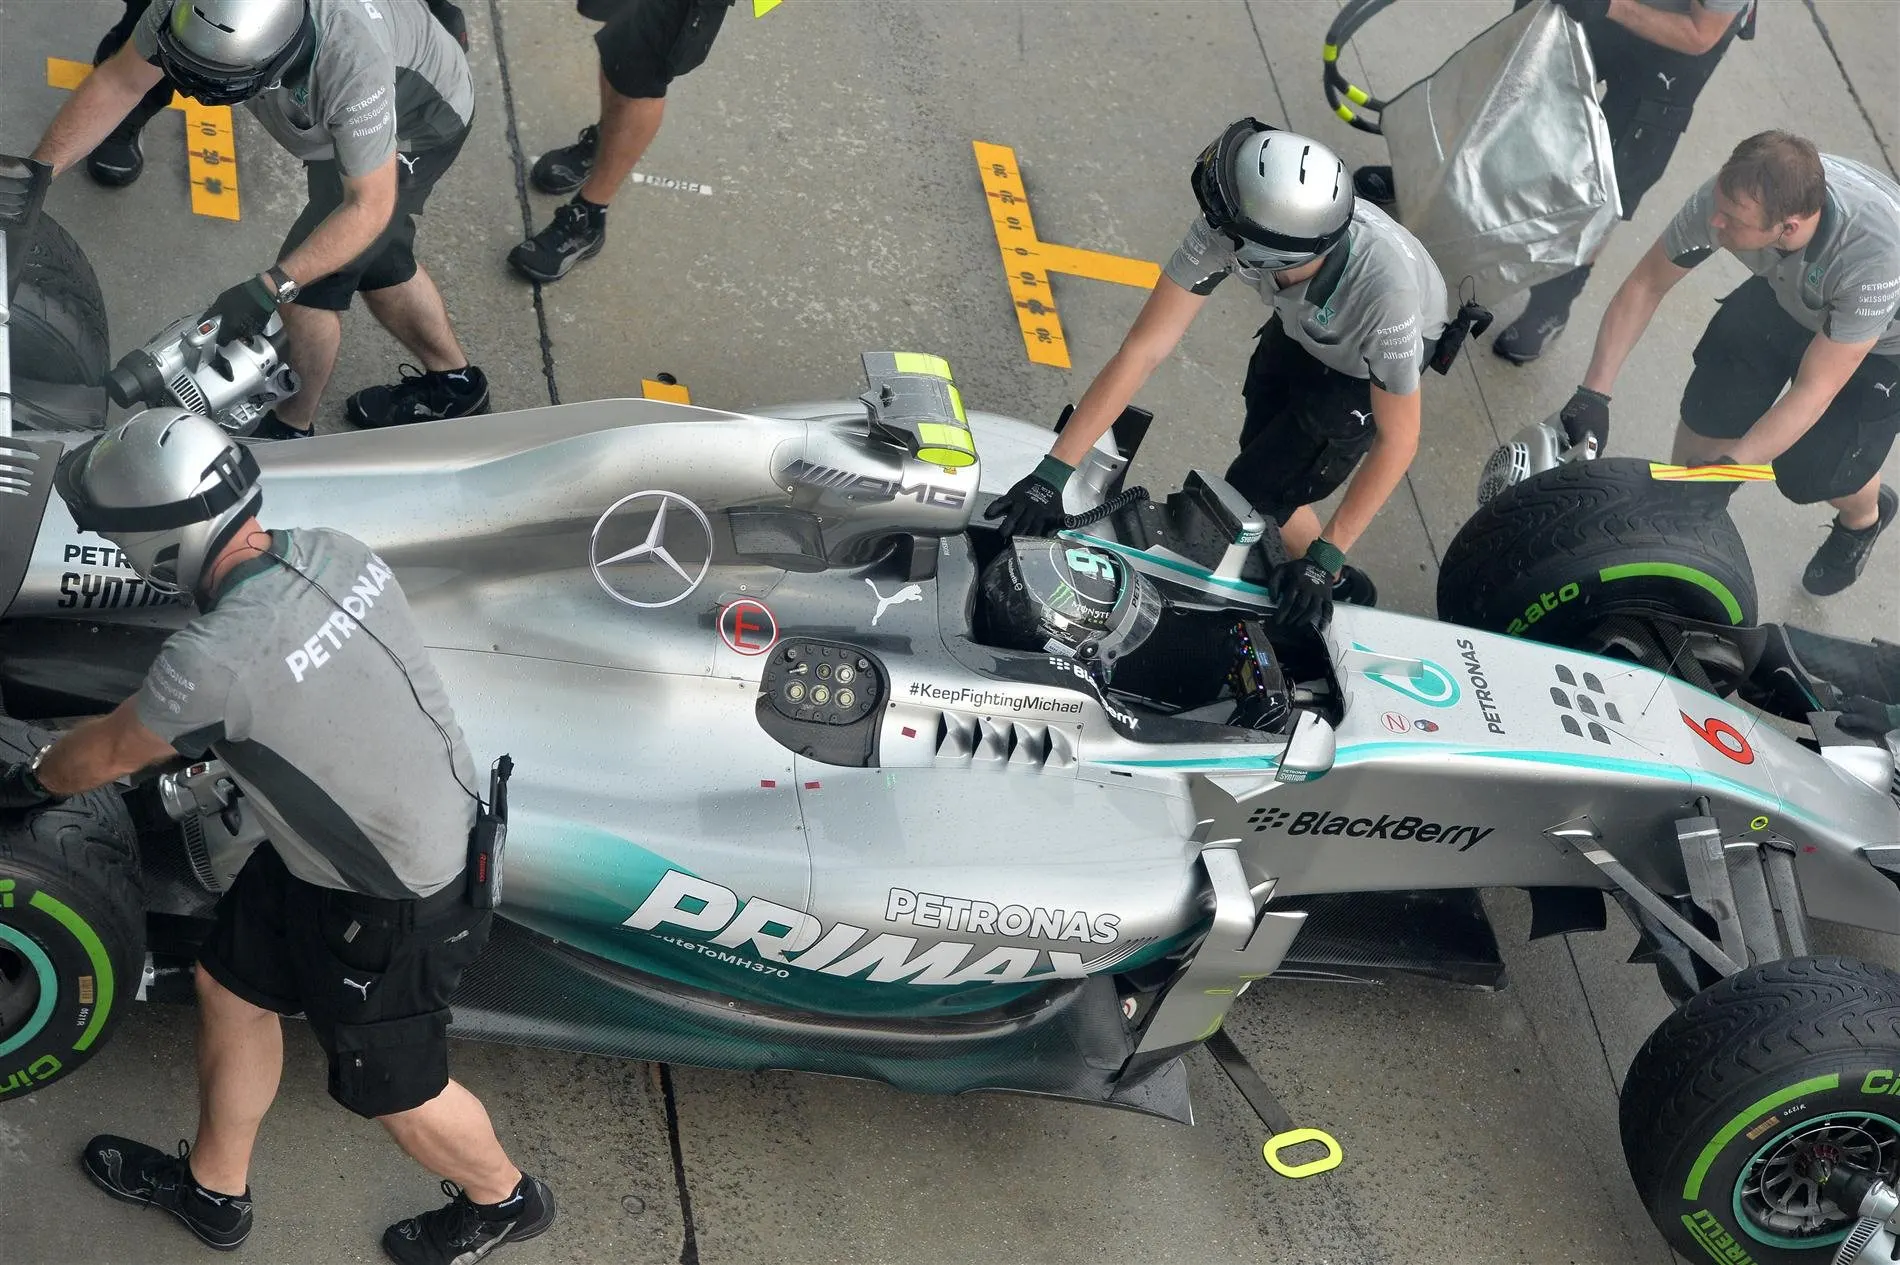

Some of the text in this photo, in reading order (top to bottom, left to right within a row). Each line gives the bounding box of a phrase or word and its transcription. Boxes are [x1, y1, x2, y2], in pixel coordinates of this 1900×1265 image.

[201, 121, 217, 136] 10
[1006, 216, 1022, 230] 10
[1021, 271, 1037, 286] 10
[735, 605, 763, 650] E
[909, 682, 1084, 714] #KeepFightingMichael
[1457, 638, 1506, 735] PETRONAS
[1678, 708, 1755, 765] 6
[1288, 800, 1495, 851] BlackBerry
[885, 887, 1122, 944] PETRONAS
